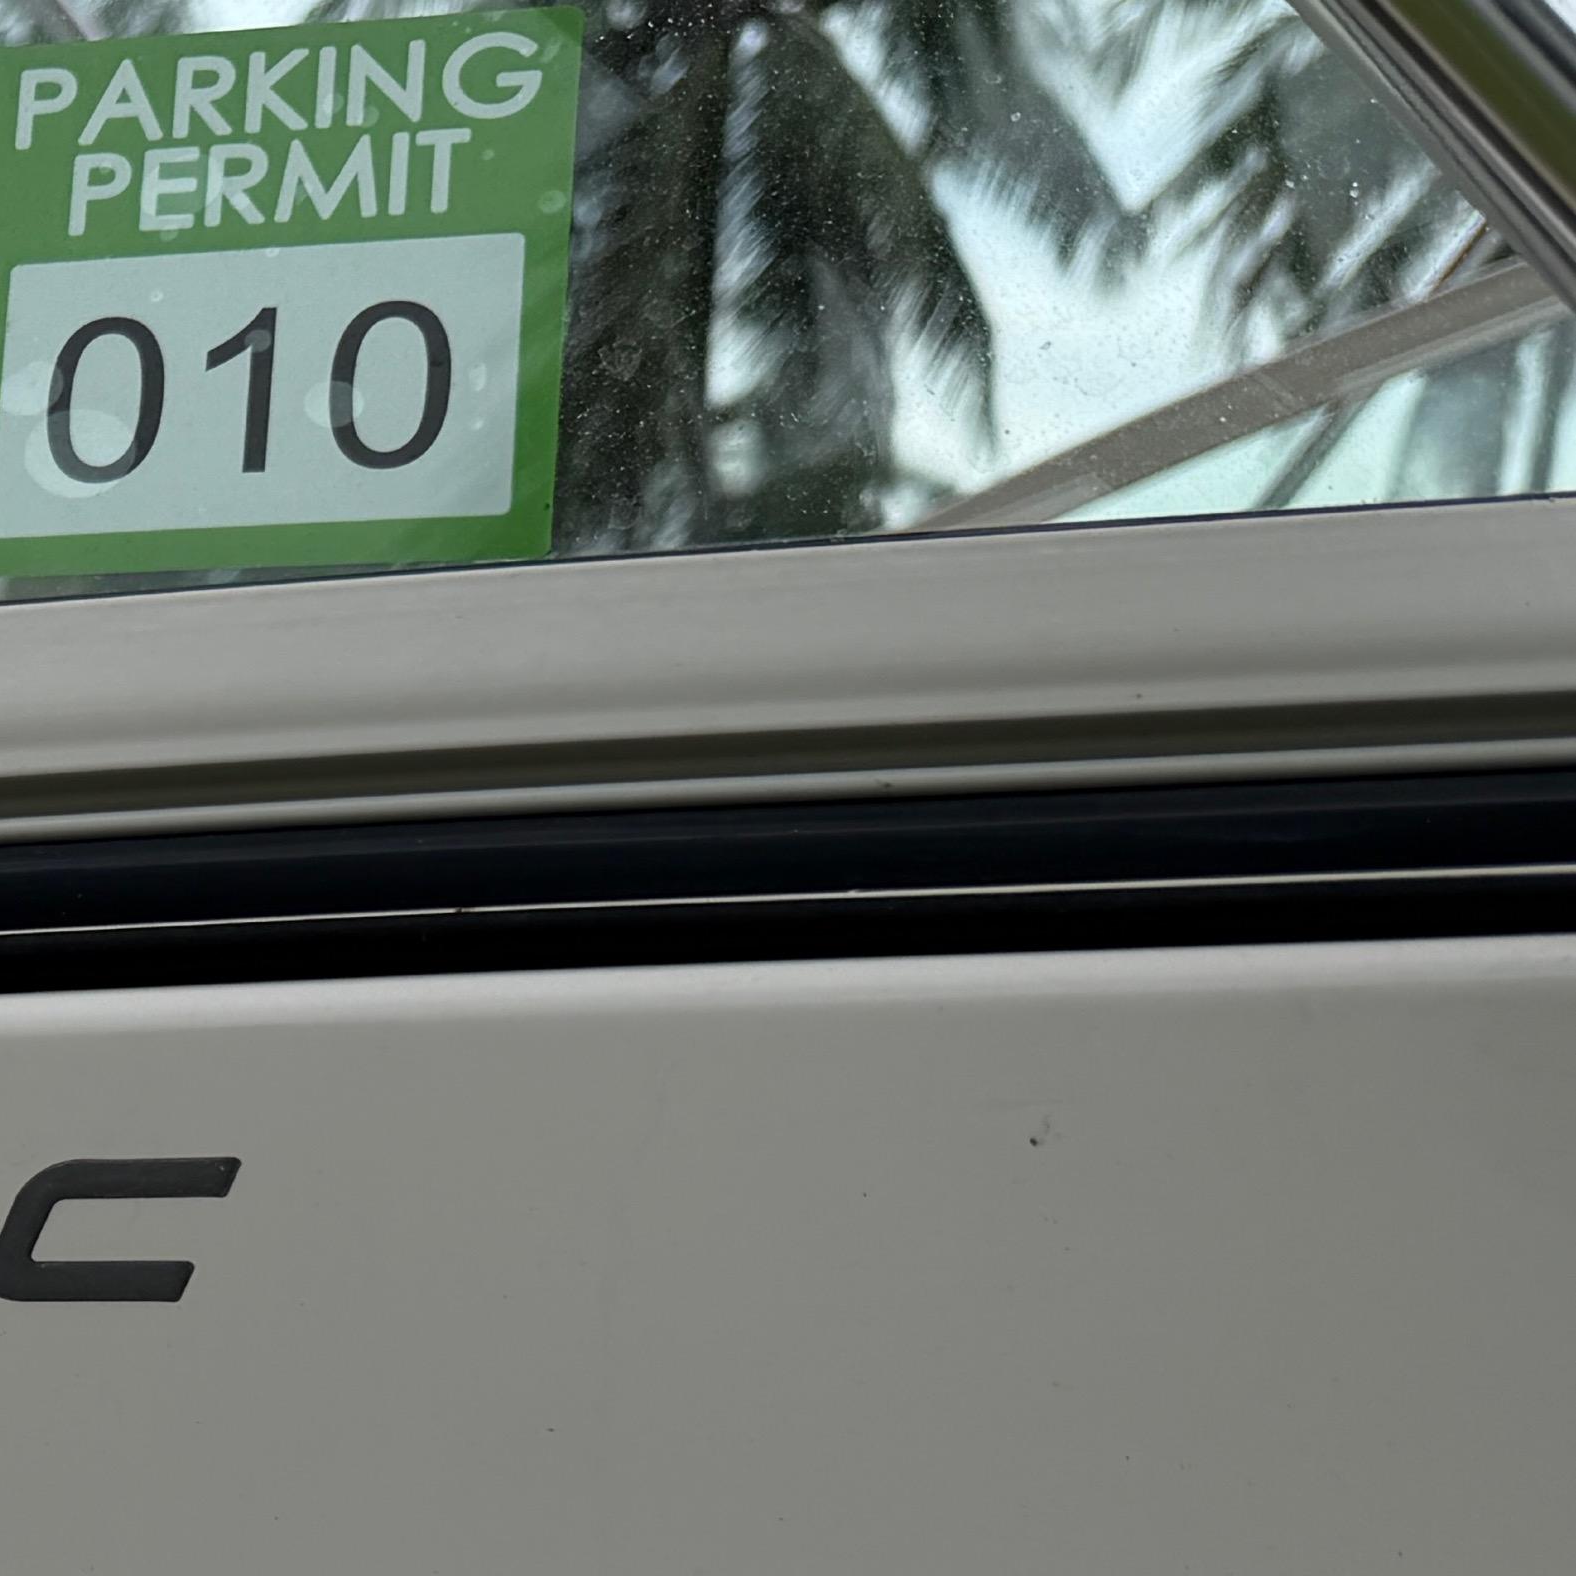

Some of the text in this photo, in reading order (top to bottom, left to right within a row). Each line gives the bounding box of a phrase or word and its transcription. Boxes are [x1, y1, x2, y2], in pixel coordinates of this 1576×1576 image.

[14, 31, 543, 150] PARKING
[67, 127, 472, 237] PERMIT
[46, 300, 452, 484] 010
